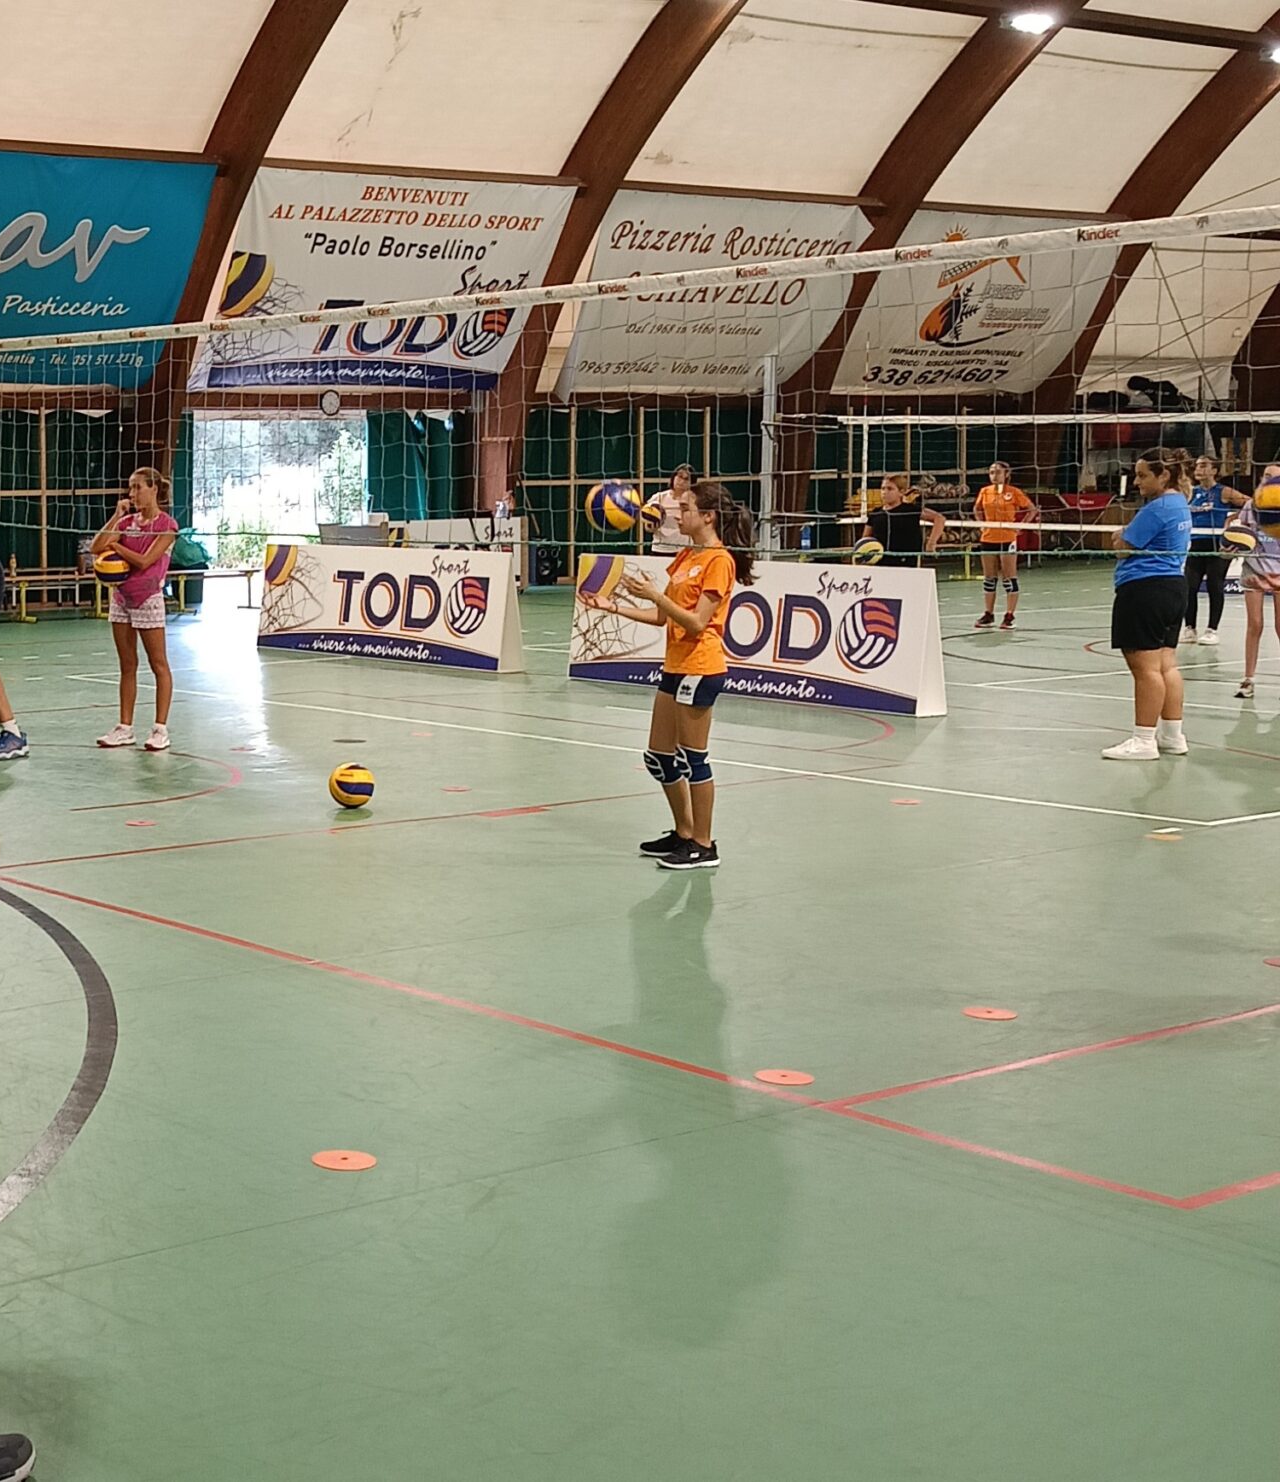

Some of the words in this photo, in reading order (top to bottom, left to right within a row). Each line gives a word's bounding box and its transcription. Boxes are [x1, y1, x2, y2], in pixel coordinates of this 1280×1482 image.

[361, 185, 469, 207] BENVENUTI
[270, 204, 294, 219] AL
[299, 205, 419, 226] PALAZZETTO
[423, 212, 481, 229] DELLO
[485, 215, 544, 232] SPORT
[610, 220, 716, 254] Pizzeria
[722, 226, 854, 260] Rosticceria
[1077, 229, 1120, 242] Kinder
[895, 248, 933, 261] Kinder
[736, 267, 769, 279] Kinder
[2, 295, 130, 316] Pasticceria
[670, 361, 699, 375] Vibo
[703, 362, 751, 375] Valentia
[863, 366, 913, 386] 338
[430, 555, 470, 576] Sport
[816, 571, 873, 597] Sport
